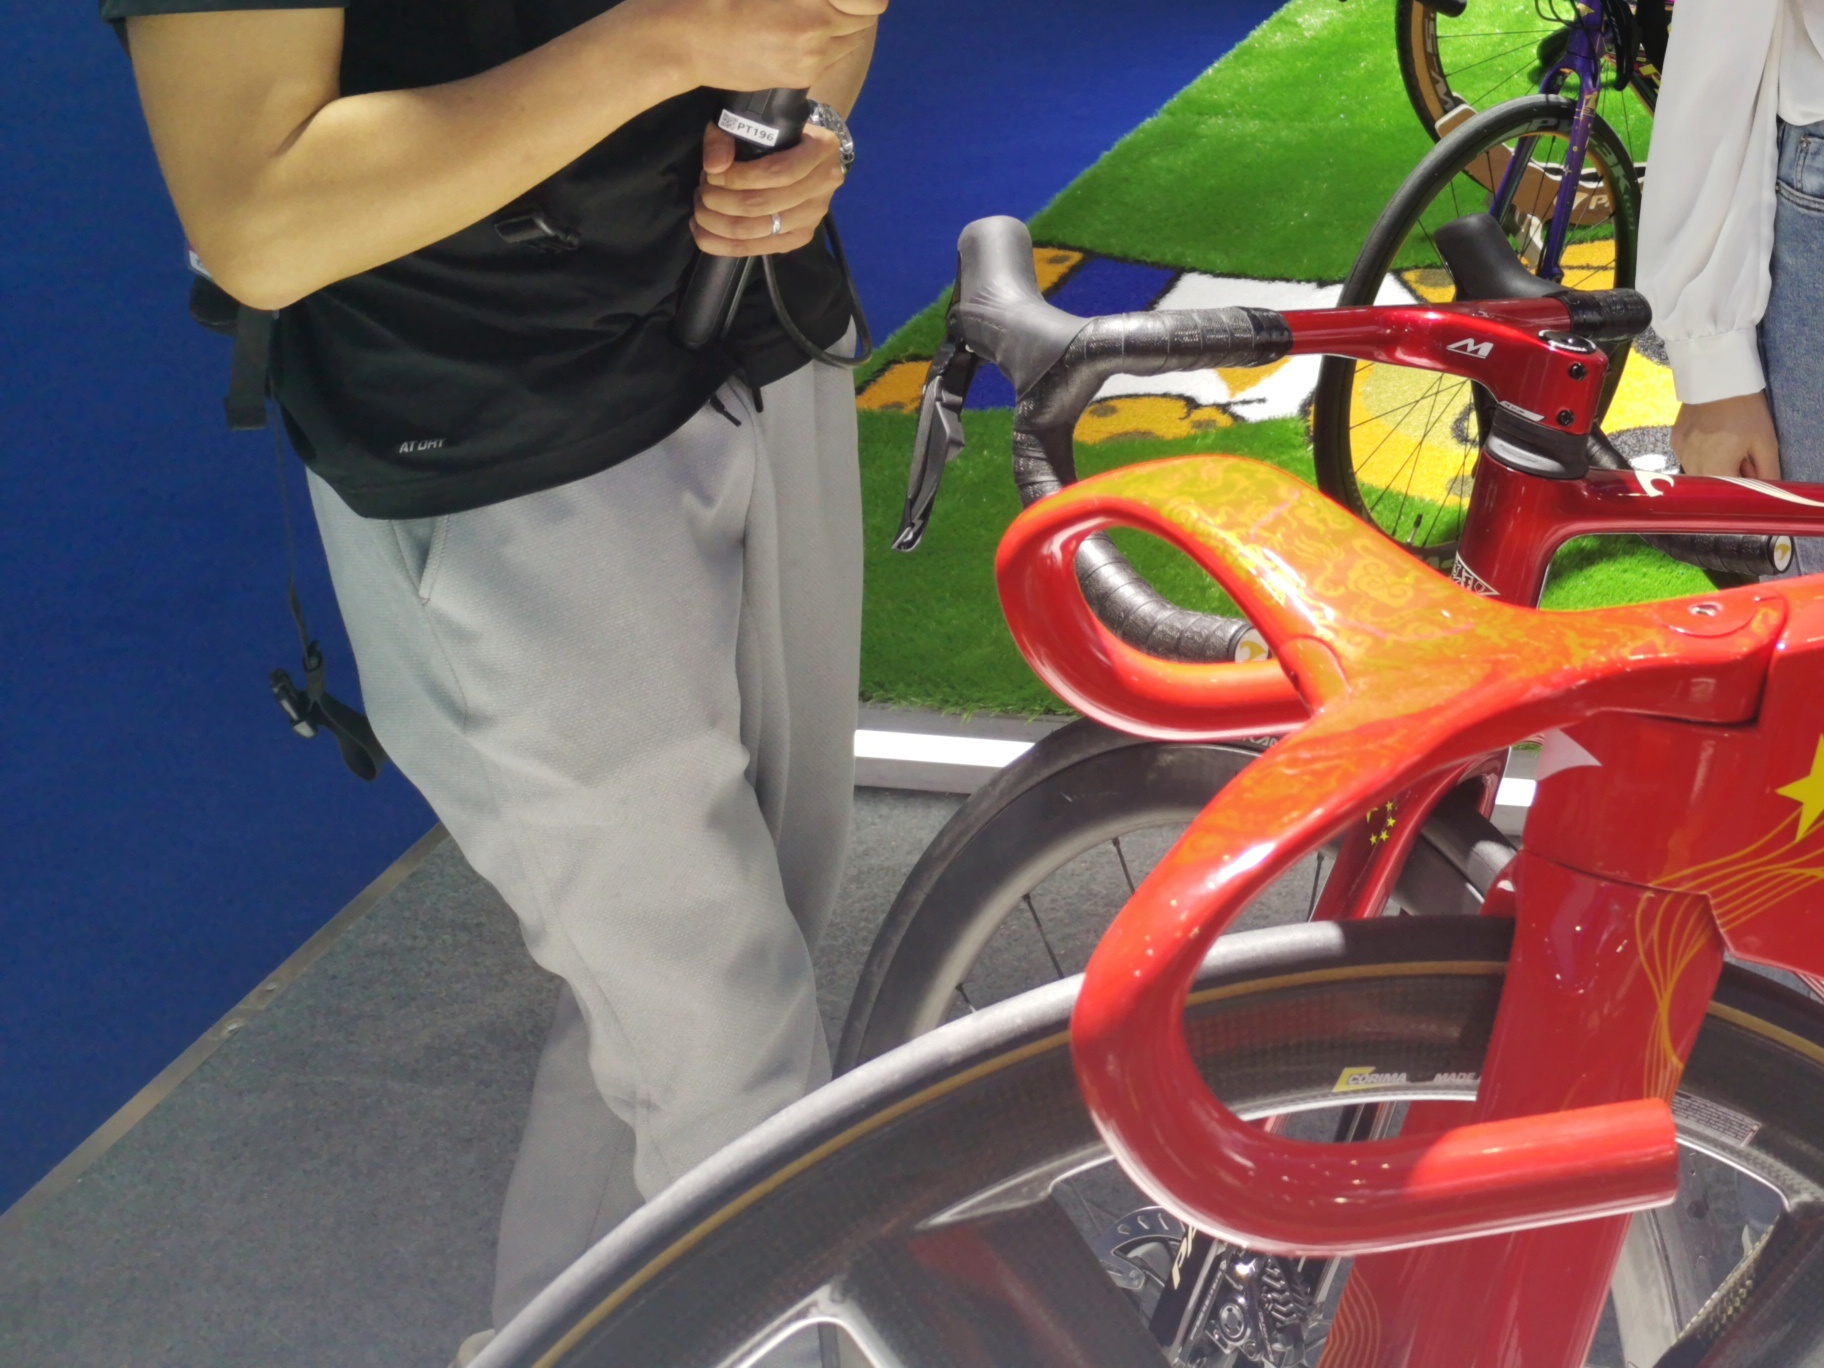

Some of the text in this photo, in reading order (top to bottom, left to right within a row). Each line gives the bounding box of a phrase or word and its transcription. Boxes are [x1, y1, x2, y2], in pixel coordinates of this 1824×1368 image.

[736, 121, 775, 142] PT196
[1349, 1072, 1477, 1086] CORIMA MADE
